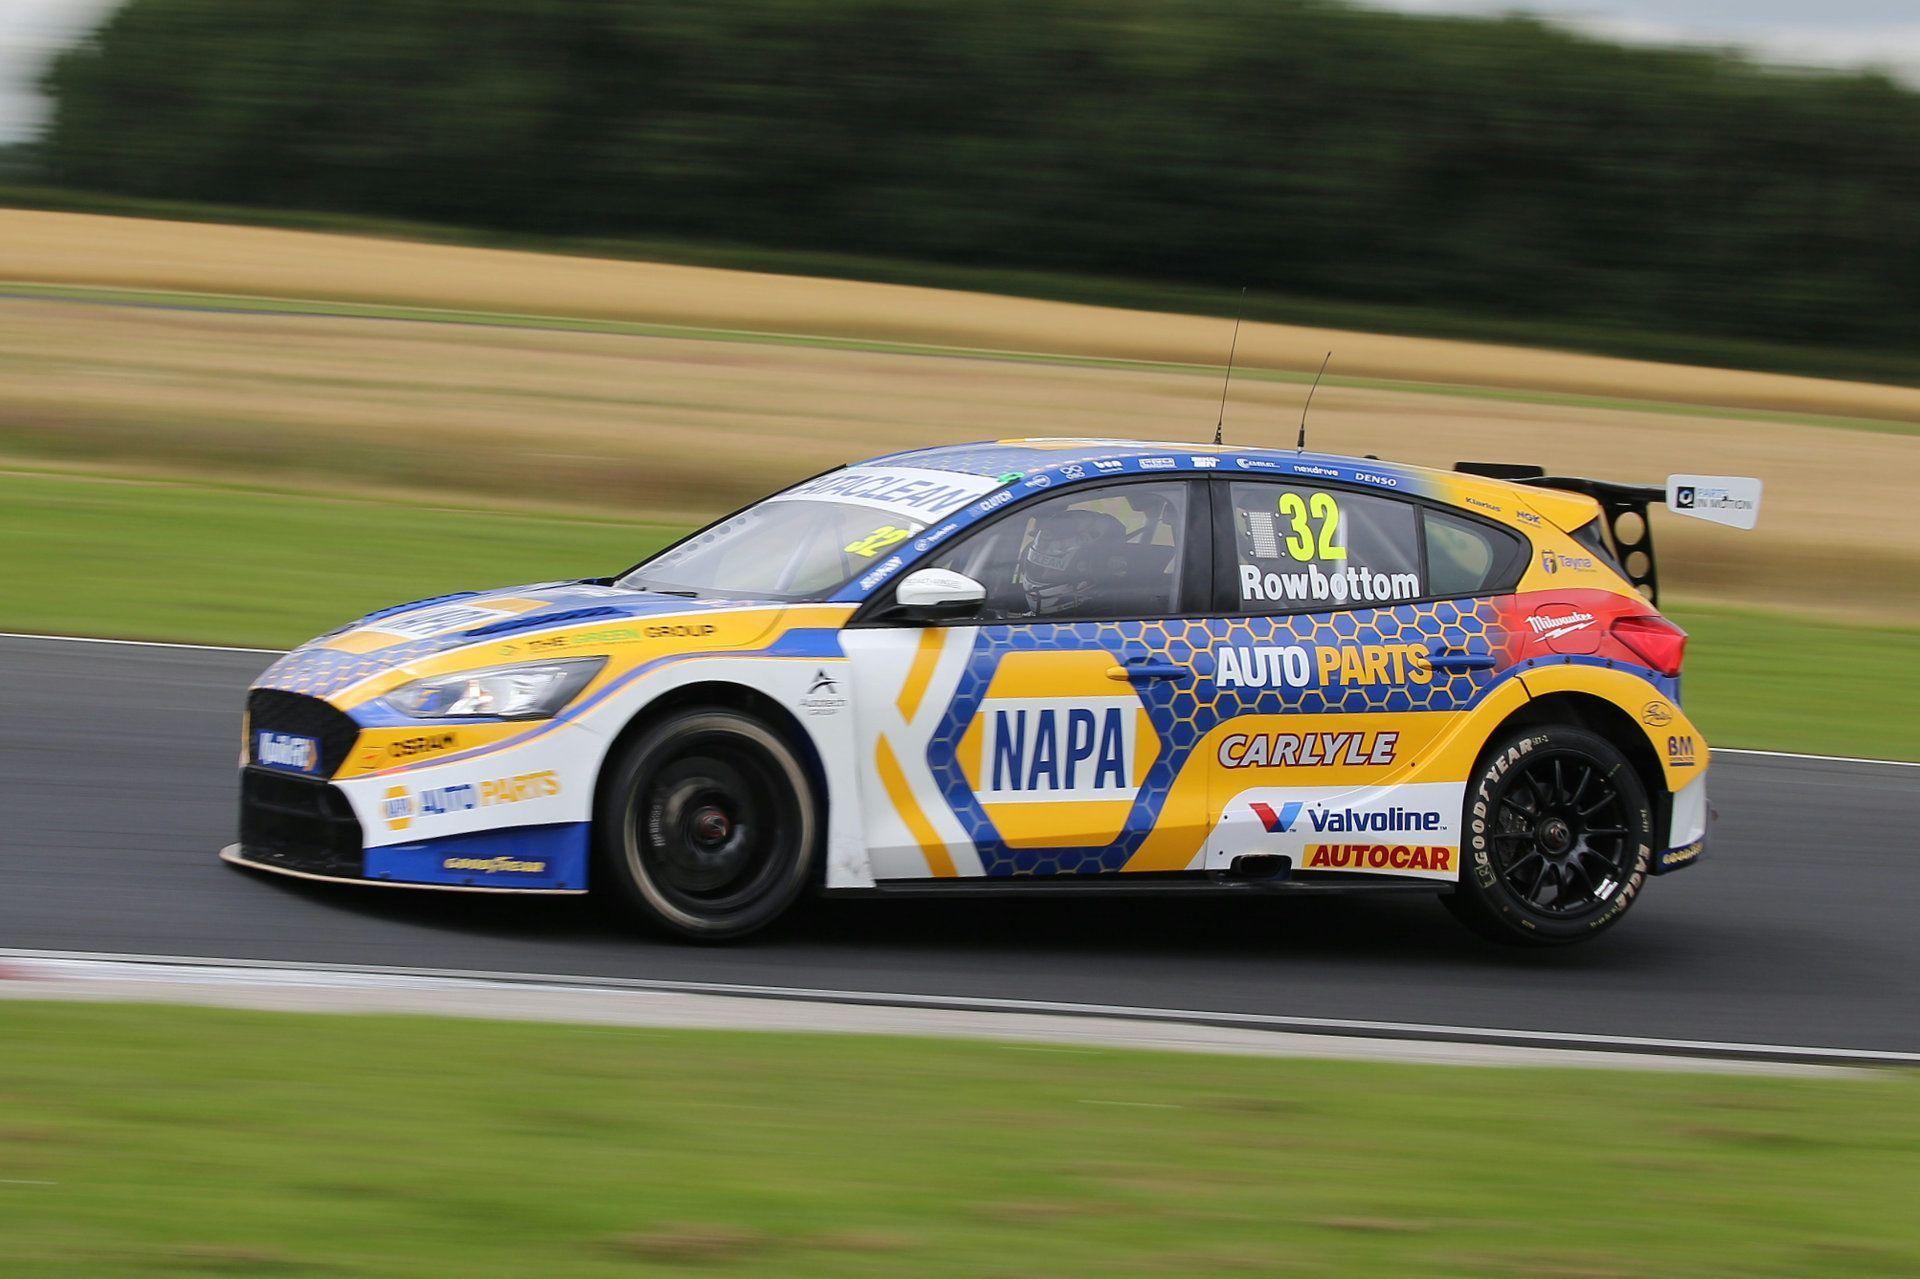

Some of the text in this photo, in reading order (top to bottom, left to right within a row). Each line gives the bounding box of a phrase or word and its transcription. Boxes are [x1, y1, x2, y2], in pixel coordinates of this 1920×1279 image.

[1293, 465, 1338, 476] nexdrive
[1355, 473, 1397, 487] DENSO
[1278, 491, 1348, 562] 32
[1557, 555, 1592, 571] Tayna
[1239, 563, 1421, 601] Rowbottom
[1524, 611, 1595, 634] Milwaukee
[528, 624, 717, 650] THE GREEN GROUP
[1215, 643, 1434, 688] AUTO PARTS
[992, 707, 1126, 792] NAPA
[1217, 731, 1400, 769] CARLYLE
[1669, 736, 1694, 756] BM
[479, 770, 561, 806] PARTS
[1307, 807, 1440, 832] Valvoline
[1309, 844, 1450, 871] AUTOCAR
